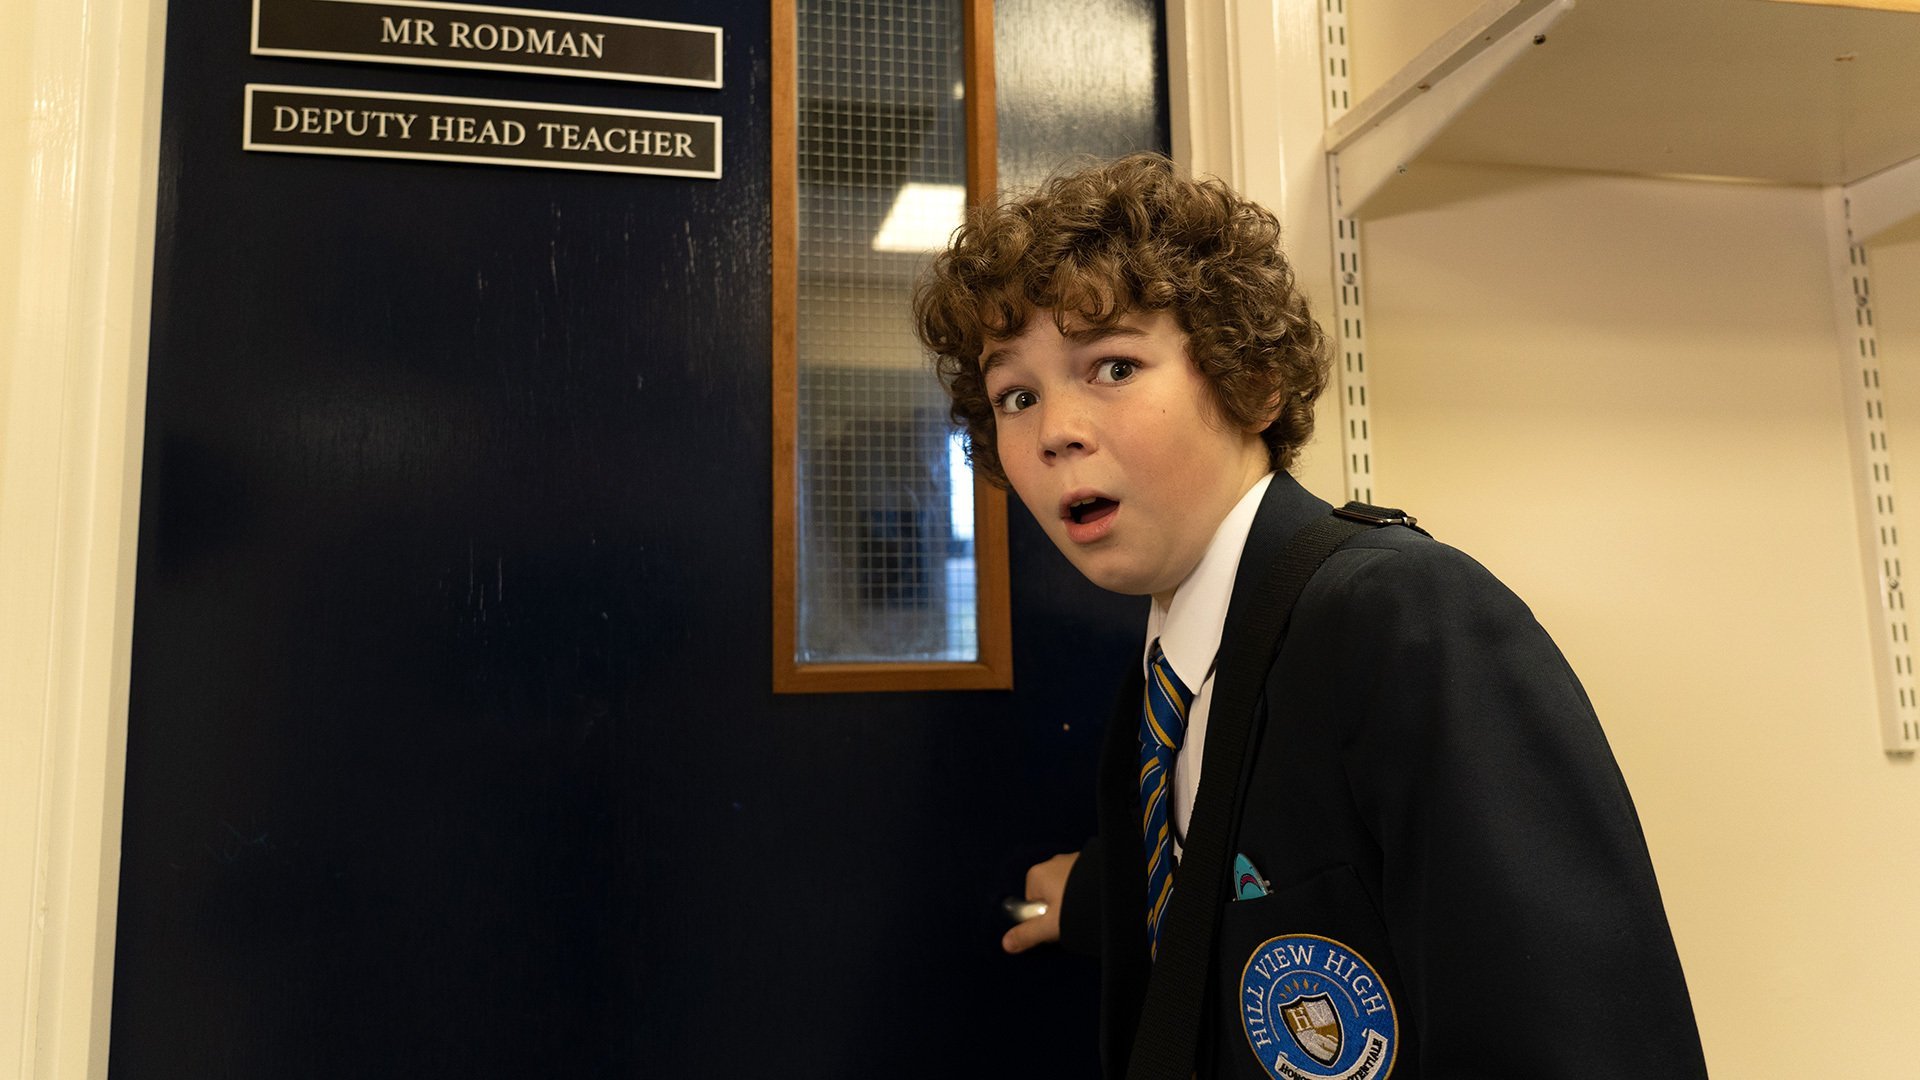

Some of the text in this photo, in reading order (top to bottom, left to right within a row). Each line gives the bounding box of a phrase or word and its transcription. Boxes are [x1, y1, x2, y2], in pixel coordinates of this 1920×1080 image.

[380, 16, 605, 59] MR RODMAN
[273, 106, 696, 158] DEPUTY HEAD TEACHER
[1247, 944, 1386, 1049] HILL VIEW HIGH
